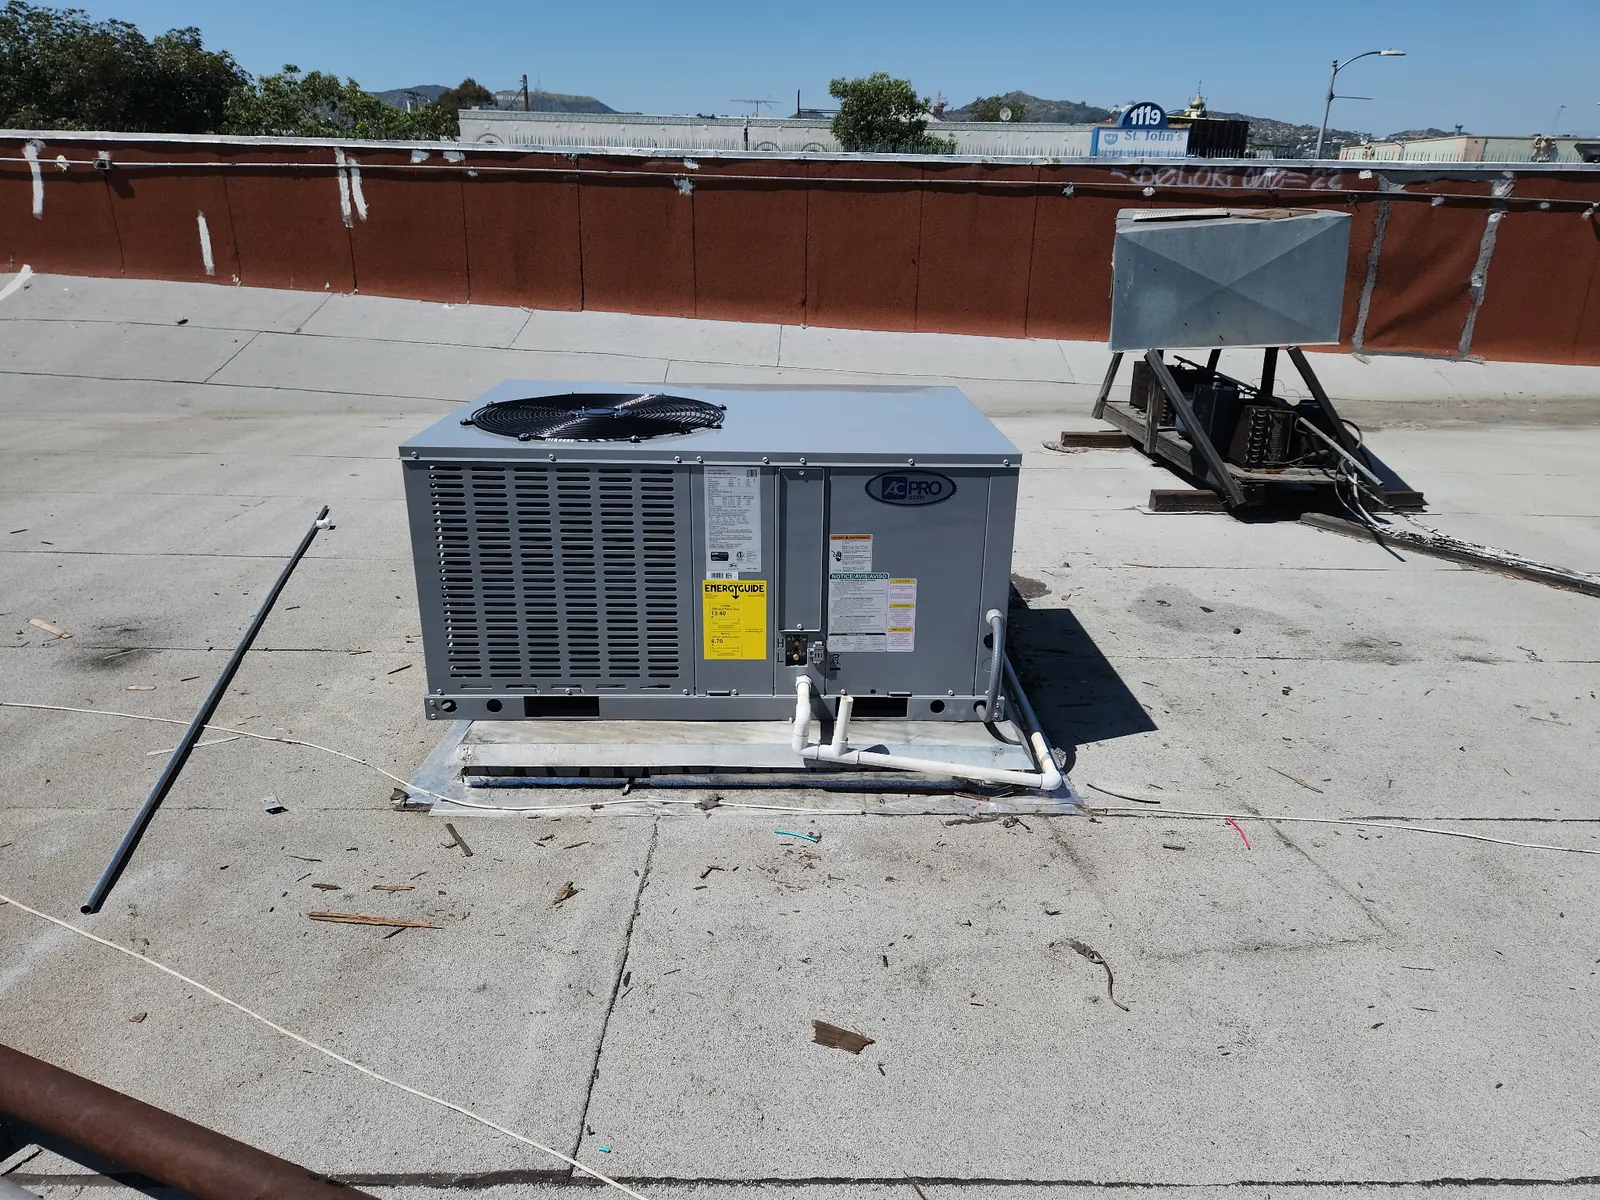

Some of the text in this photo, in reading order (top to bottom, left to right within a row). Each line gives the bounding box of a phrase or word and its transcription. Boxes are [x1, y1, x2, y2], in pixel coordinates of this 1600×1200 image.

[1130, 105, 1161, 125] 1119
[1124, 130, 1184, 142] St. John's
[883, 480, 942, 496] AC PRO
[704, 584, 765, 595] ENERGYGUIDE
